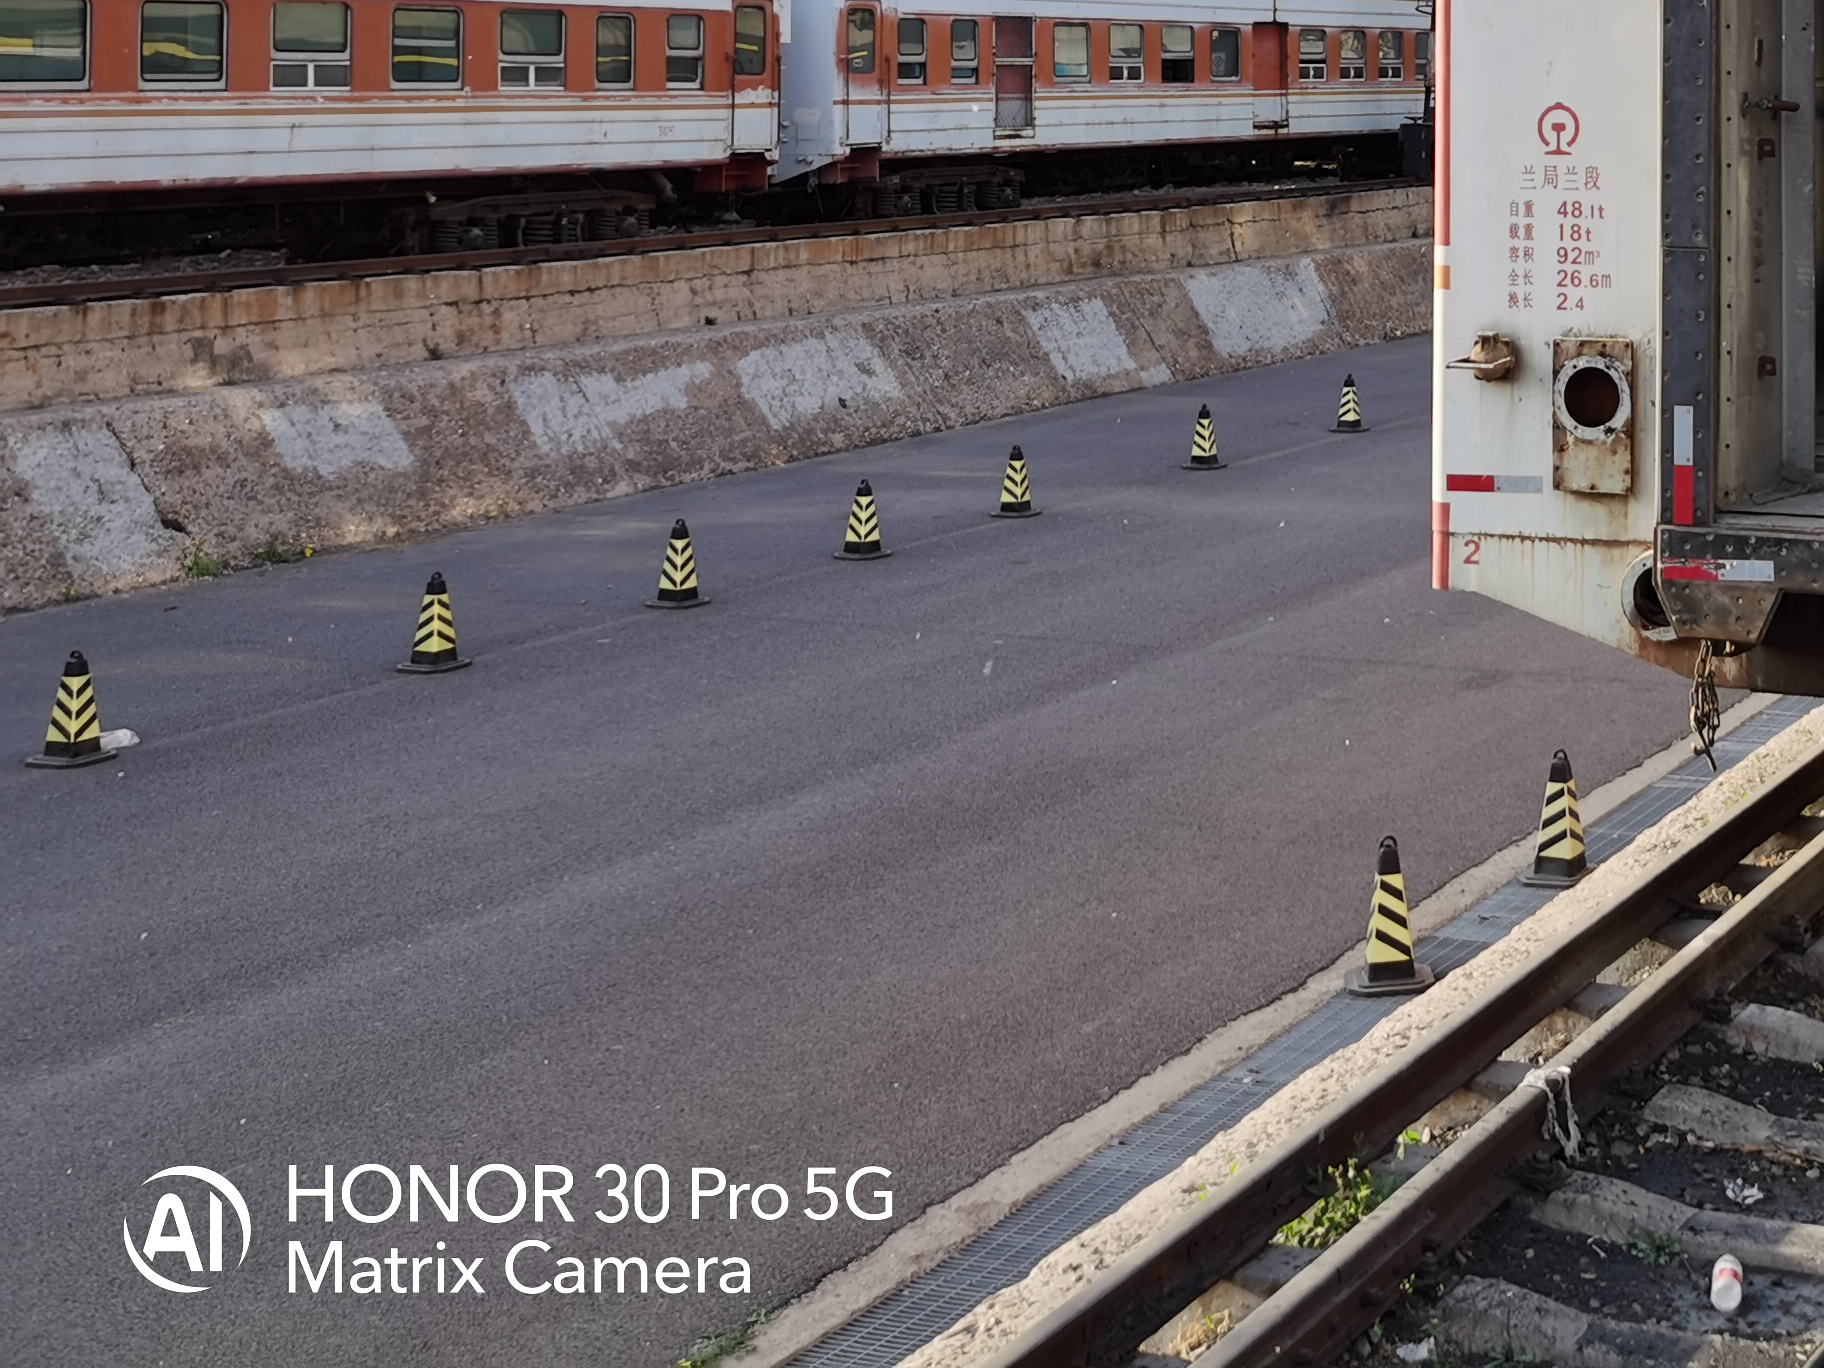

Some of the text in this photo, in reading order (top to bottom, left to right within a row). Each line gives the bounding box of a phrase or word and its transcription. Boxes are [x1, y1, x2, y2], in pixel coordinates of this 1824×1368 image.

[1520, 164, 1601, 191] 兰局兰段
[1509, 199, 1605, 220] 自重 48.1t
[1559, 223, 1592, 242] 18t
[1508, 245, 1534, 264] 容积
[1508, 268, 1612, 289] 全长 26.6m
[1508, 290, 1585, 311] 换长 2.4
[1462, 539, 1481, 565] 2
